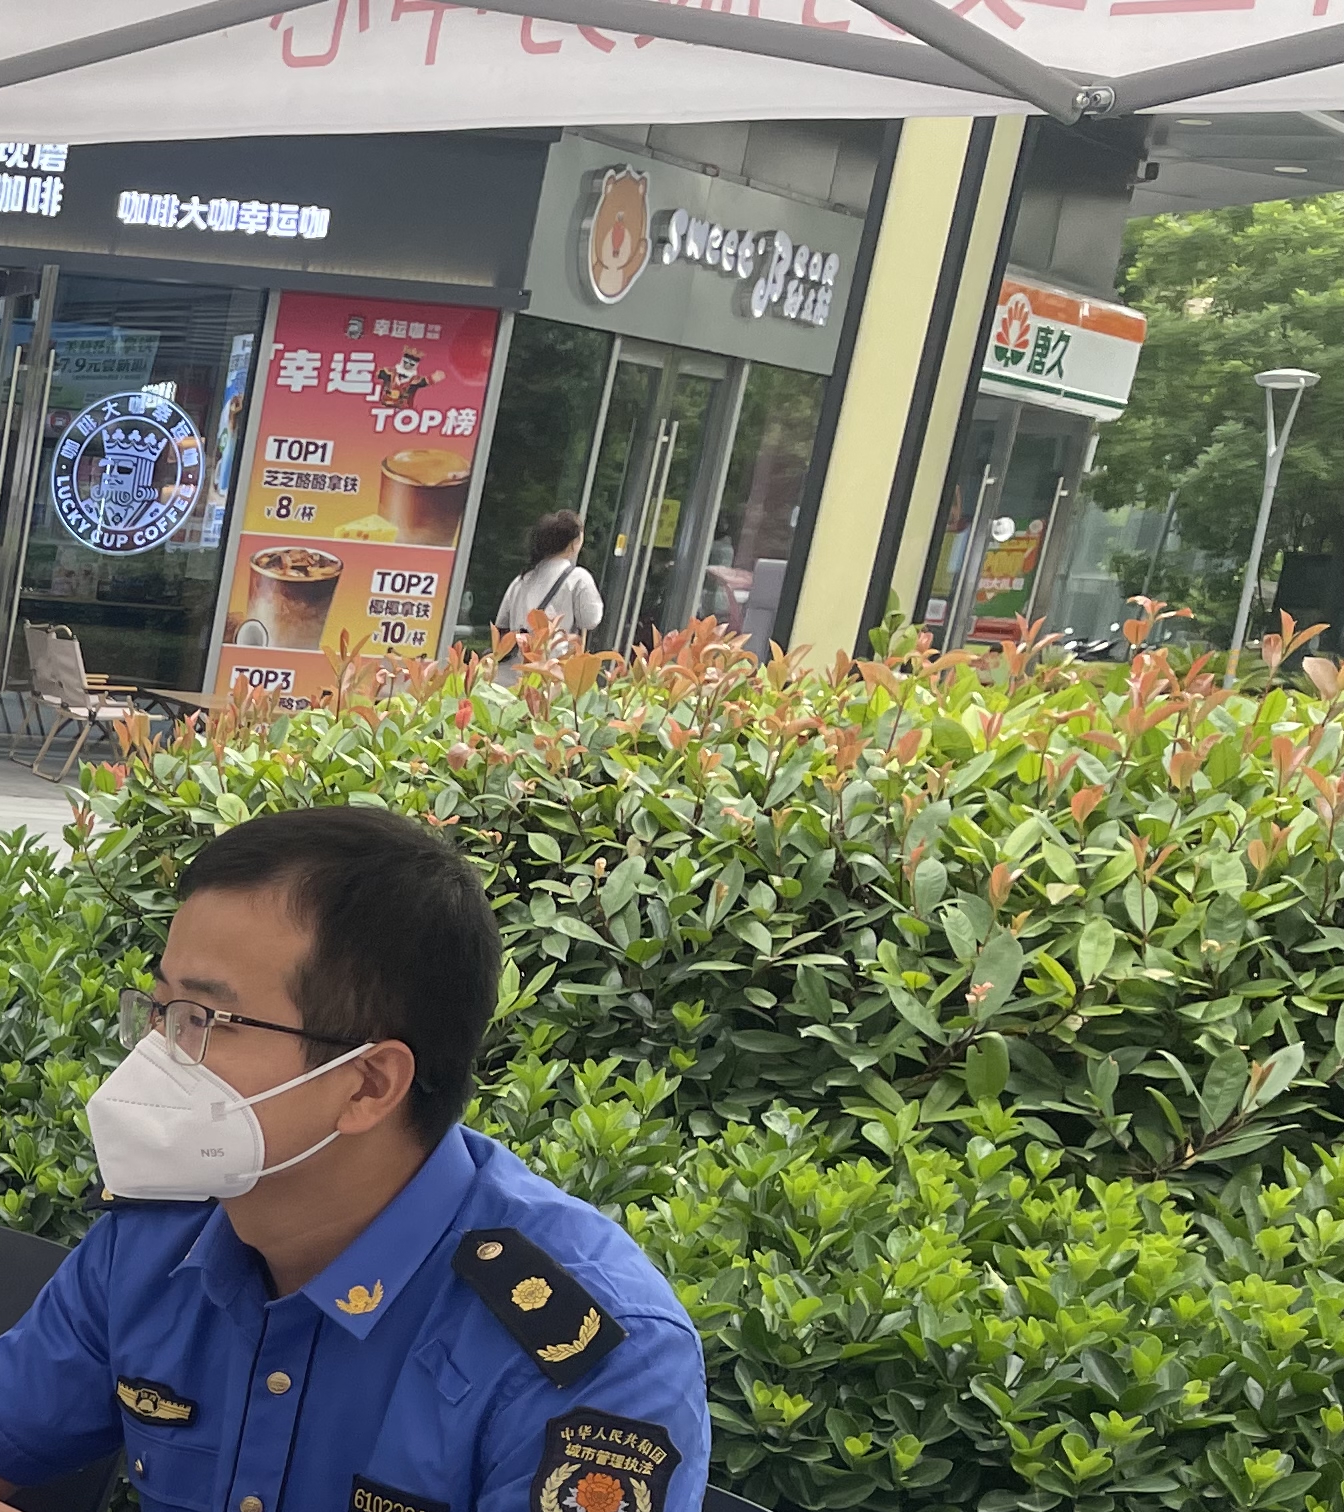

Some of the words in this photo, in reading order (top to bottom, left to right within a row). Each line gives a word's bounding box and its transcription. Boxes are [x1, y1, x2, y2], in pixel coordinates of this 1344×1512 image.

[118, 189, 331, 240] 咖啡大咖幸运咖
[1028, 325, 1071, 379] 唐久
[370, 407, 480, 438] TOP榜
[273, 439, 328, 464] TOP1
[263, 469, 361, 493] 芝芝酪酪拿铁
[57, 475, 91, 534] LUCKY
[133, 484, 196, 545] COFFEE
[376, 572, 435, 595] TOP2
[369, 600, 431, 619] 椰椰拿铁
[235, 667, 292, 691] TOP3
[200, 1148, 225, 1157] N95
[561, 1425, 667, 1465] 中华人民共和国
[565, 1442, 654, 1475] 城市管理执法
